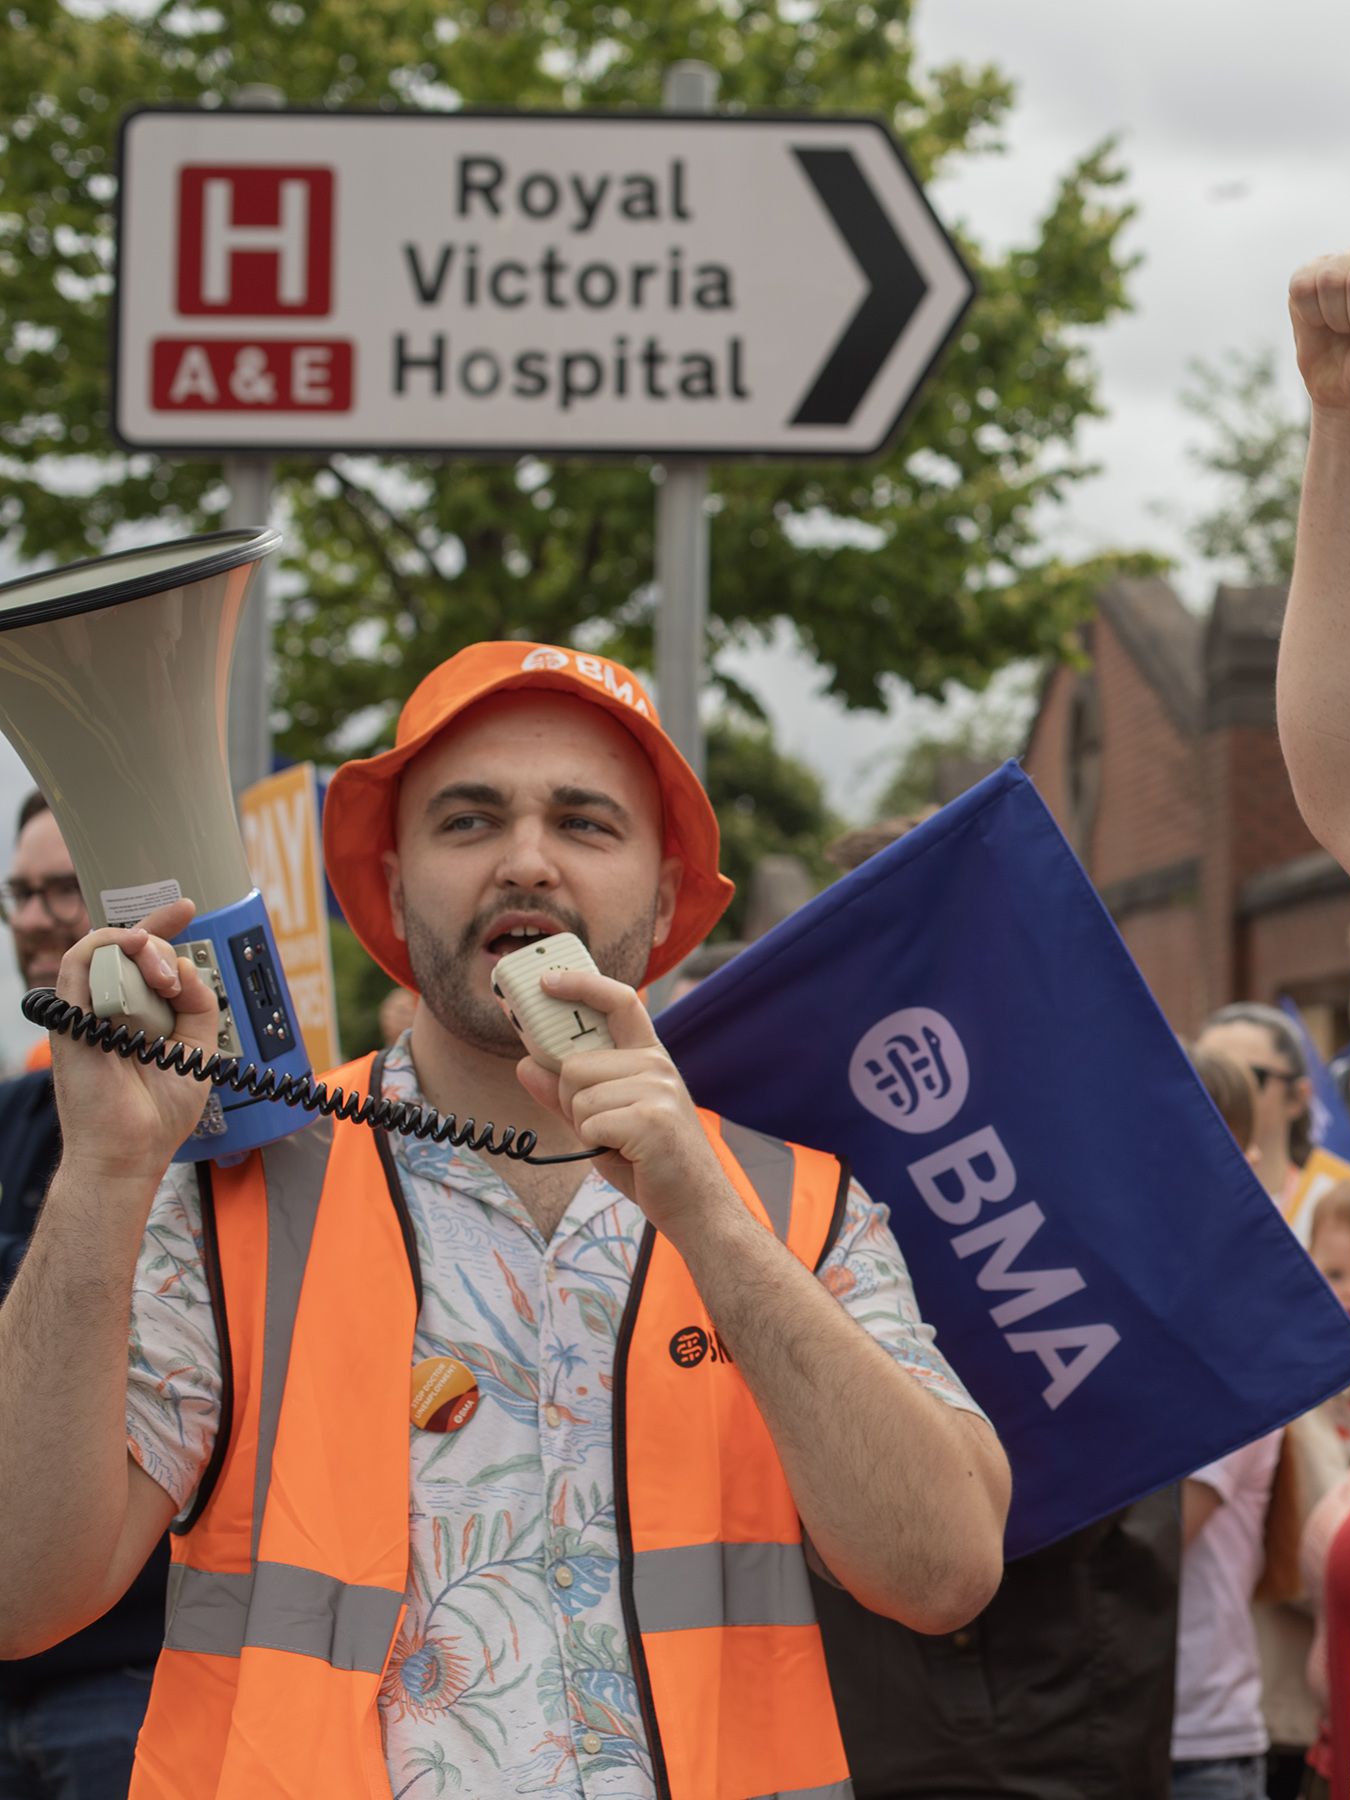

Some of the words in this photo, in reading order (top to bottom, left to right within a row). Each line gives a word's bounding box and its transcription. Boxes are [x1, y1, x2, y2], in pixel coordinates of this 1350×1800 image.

[456, 154, 692, 233] Royal
[202, 179, 308, 304] H
[403, 243, 735, 311] Victoria
[392, 332, 750, 411] Hospital
[906, 1124, 1122, 1411] BMA
